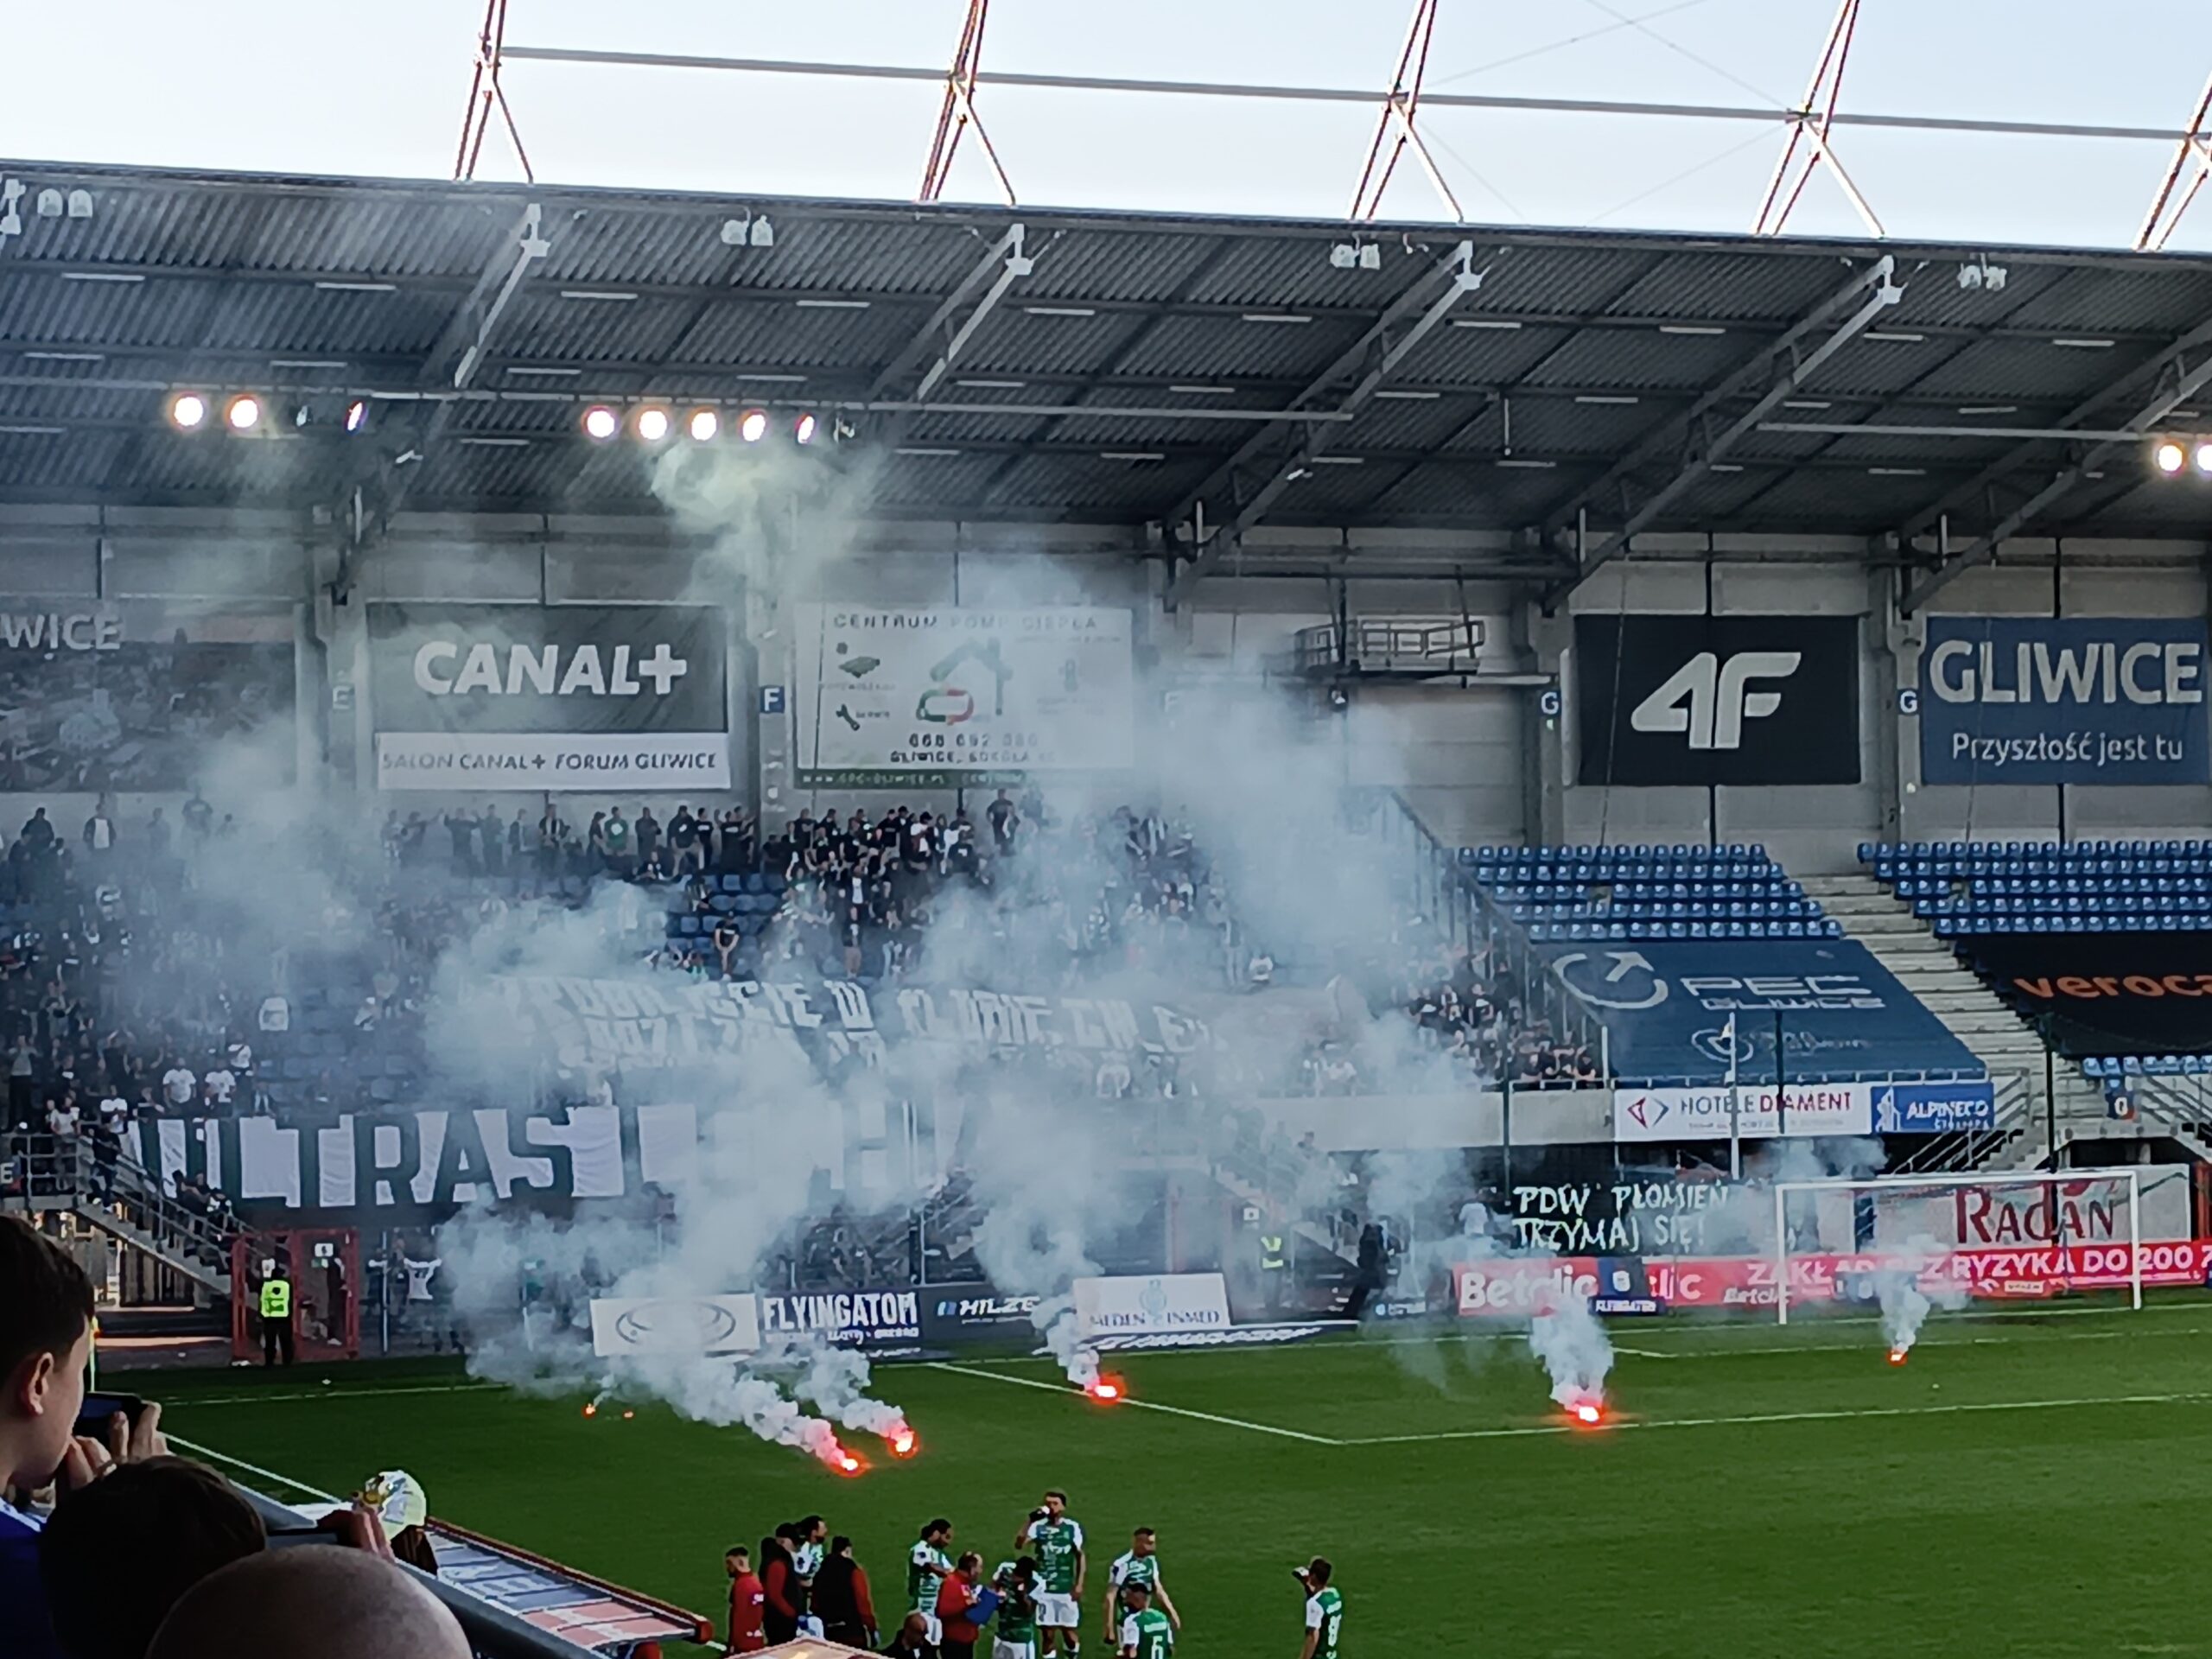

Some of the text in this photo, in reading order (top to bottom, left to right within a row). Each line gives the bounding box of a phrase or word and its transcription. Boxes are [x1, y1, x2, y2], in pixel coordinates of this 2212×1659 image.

[0, 613, 121, 650] WICE
[834, 613, 938, 629] CENTRUM
[414, 641, 687, 695] CANAL+
[1929, 639, 2202, 704] GLIWICE
[765, 688, 779, 711] F
[1541, 692, 1559, 715] G
[1631, 652, 1802, 749] 4F
[1900, 691, 1917, 713] G
[383, 753, 454, 770] SALON
[556, 753, 629, 770] FORUM
[635, 753, 717, 769] GLIWICE
[1953, 733, 2183, 766] Przyszłość jest tu
[1680, 976, 1872, 996] PEC
[1512, 1217, 1640, 1252] TRZYMAJ
[1951, 1250, 2075, 1280] RYZYKA
[2082, 1249, 2128, 1273] DO
[2138, 1245, 2194, 1270] 200
[762, 1293, 918, 1332] FLYINGATOM
